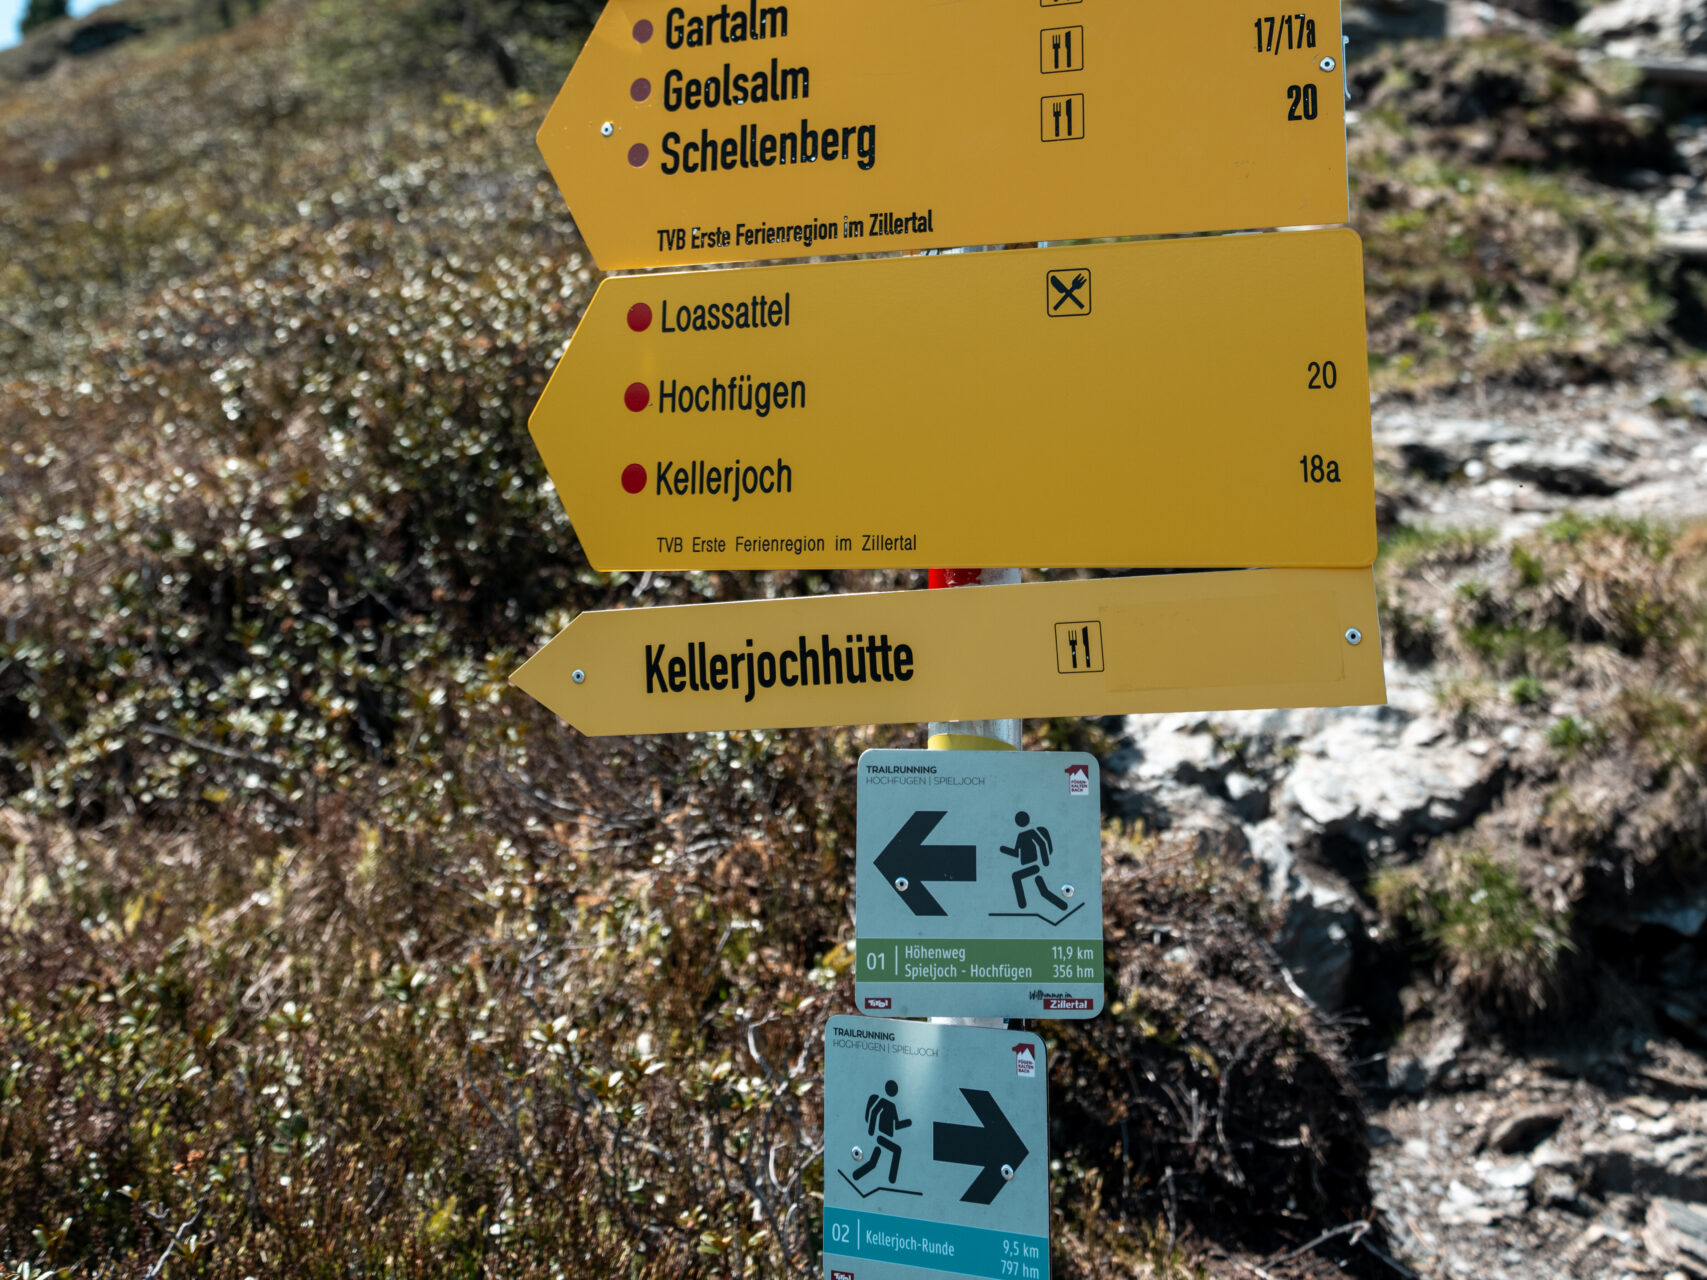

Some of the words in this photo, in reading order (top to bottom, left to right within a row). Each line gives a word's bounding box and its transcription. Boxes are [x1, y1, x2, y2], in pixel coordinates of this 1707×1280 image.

[1254, 13, 1317, 56] 17/17a
[663, 57, 810, 112] Geolsalm
[1286, 83, 1318, 122] 20
[660, 118, 876, 176] Schellenberg
[657, 228, 686, 252] TVB
[691, 226, 731, 249] Erste
[735, 217, 838, 248] Ferienregion
[843, 215, 864, 239] im
[868, 209, 934, 237] Zillertal
[661, 292, 790, 333] Loassattel
[1307, 360, 1337, 390] 20
[659, 374, 806, 418] Hochfügen
[1299, 454, 1342, 483] 18a
[656, 457, 792, 502] Kellerjoch
[656, 536, 683, 553] TVB
[692, 536, 726, 553] Erste
[735, 535, 825, 556] Ferienregion
[835, 535, 852, 551] im
[861, 534, 917, 551] Zillertal
[645, 633, 914, 703] Kellerjochhütte
[866, 766, 937, 774] TRAILRUNNING
[934, 776, 985, 786] SPIELJOCH
[866, 953, 885, 970] 01
[905, 945, 966, 961] Höhenweg
[1052, 946, 1073, 961] 11,9
[1077, 946, 1094, 960] km
[905, 964, 957, 980] Spieljoch
[970, 964, 1032, 980] Hochfügen
[1053, 965, 1073, 978] 356
[1077, 965, 1094, 978] hm
[1050, 1000, 1088, 1009] Zillertal
[833, 1028, 895, 1041] TRAILRUNNING
[892, 1044, 939, 1057] SPIELJOCH
[832, 1223, 850, 1243] 02
[866, 1230, 955, 1257] Kellerjoch-Runde
[1003, 1239, 1020, 1257] 9,5
[1023, 1242, 1039, 1259] km
[1001, 1259, 1018, 1276] 797
[1022, 1262, 1039, 1280] hm
